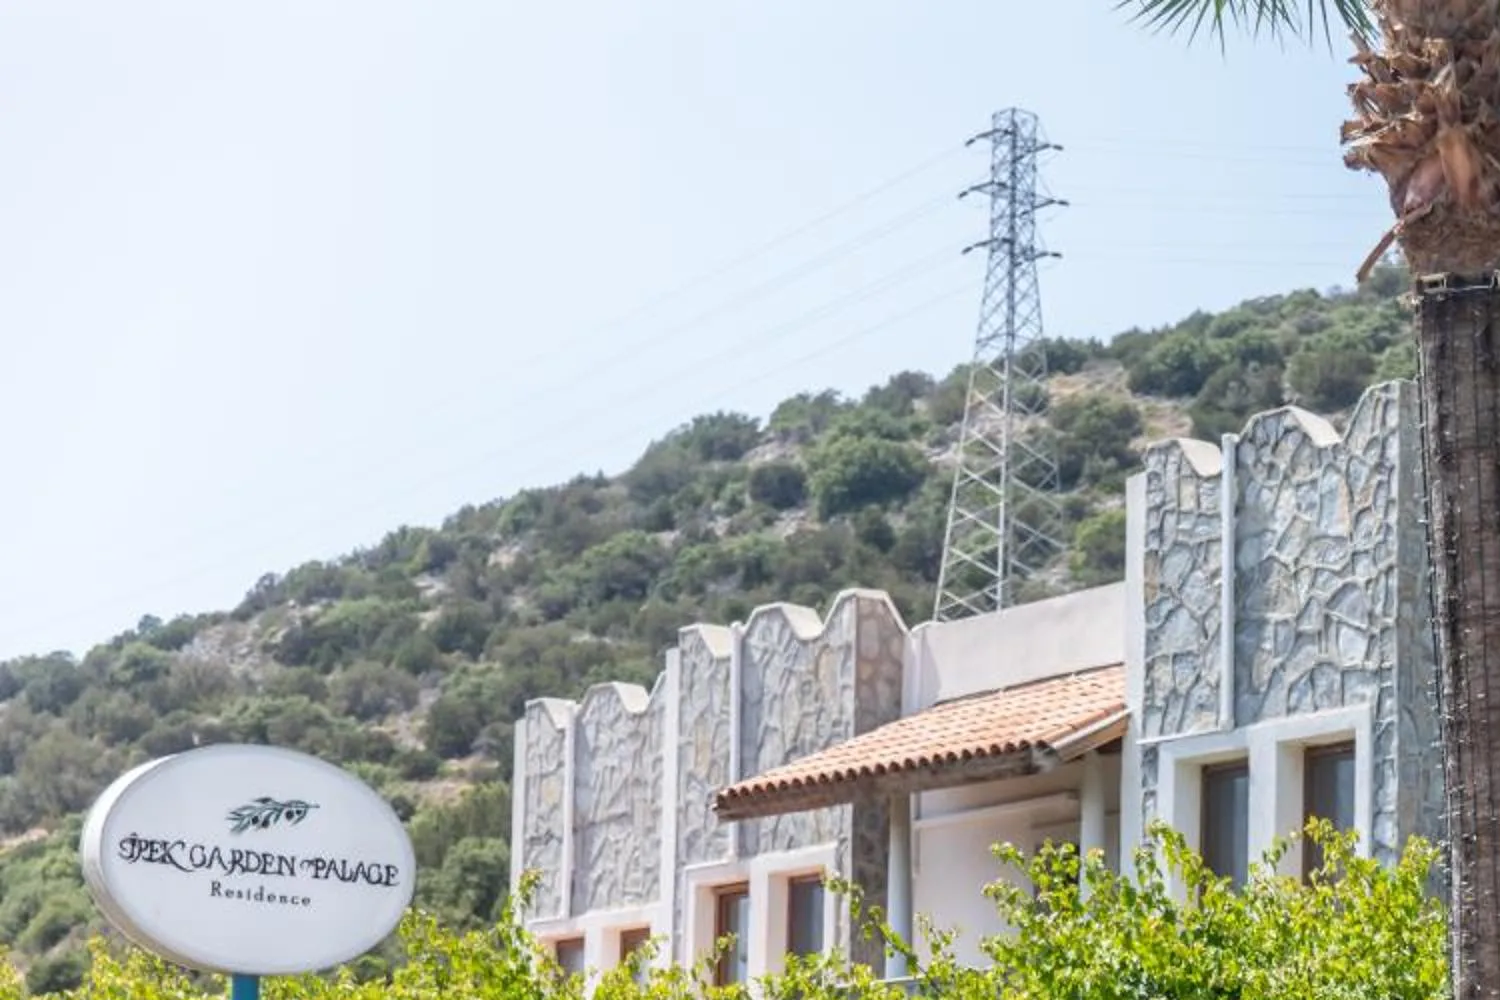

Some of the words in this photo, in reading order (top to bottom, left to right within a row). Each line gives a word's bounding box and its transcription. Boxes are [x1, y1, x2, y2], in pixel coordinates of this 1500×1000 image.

[189, 844, 296, 876] GARDEN
[299, 857, 400, 887] PALACE
[209, 880, 312, 907] Residence
